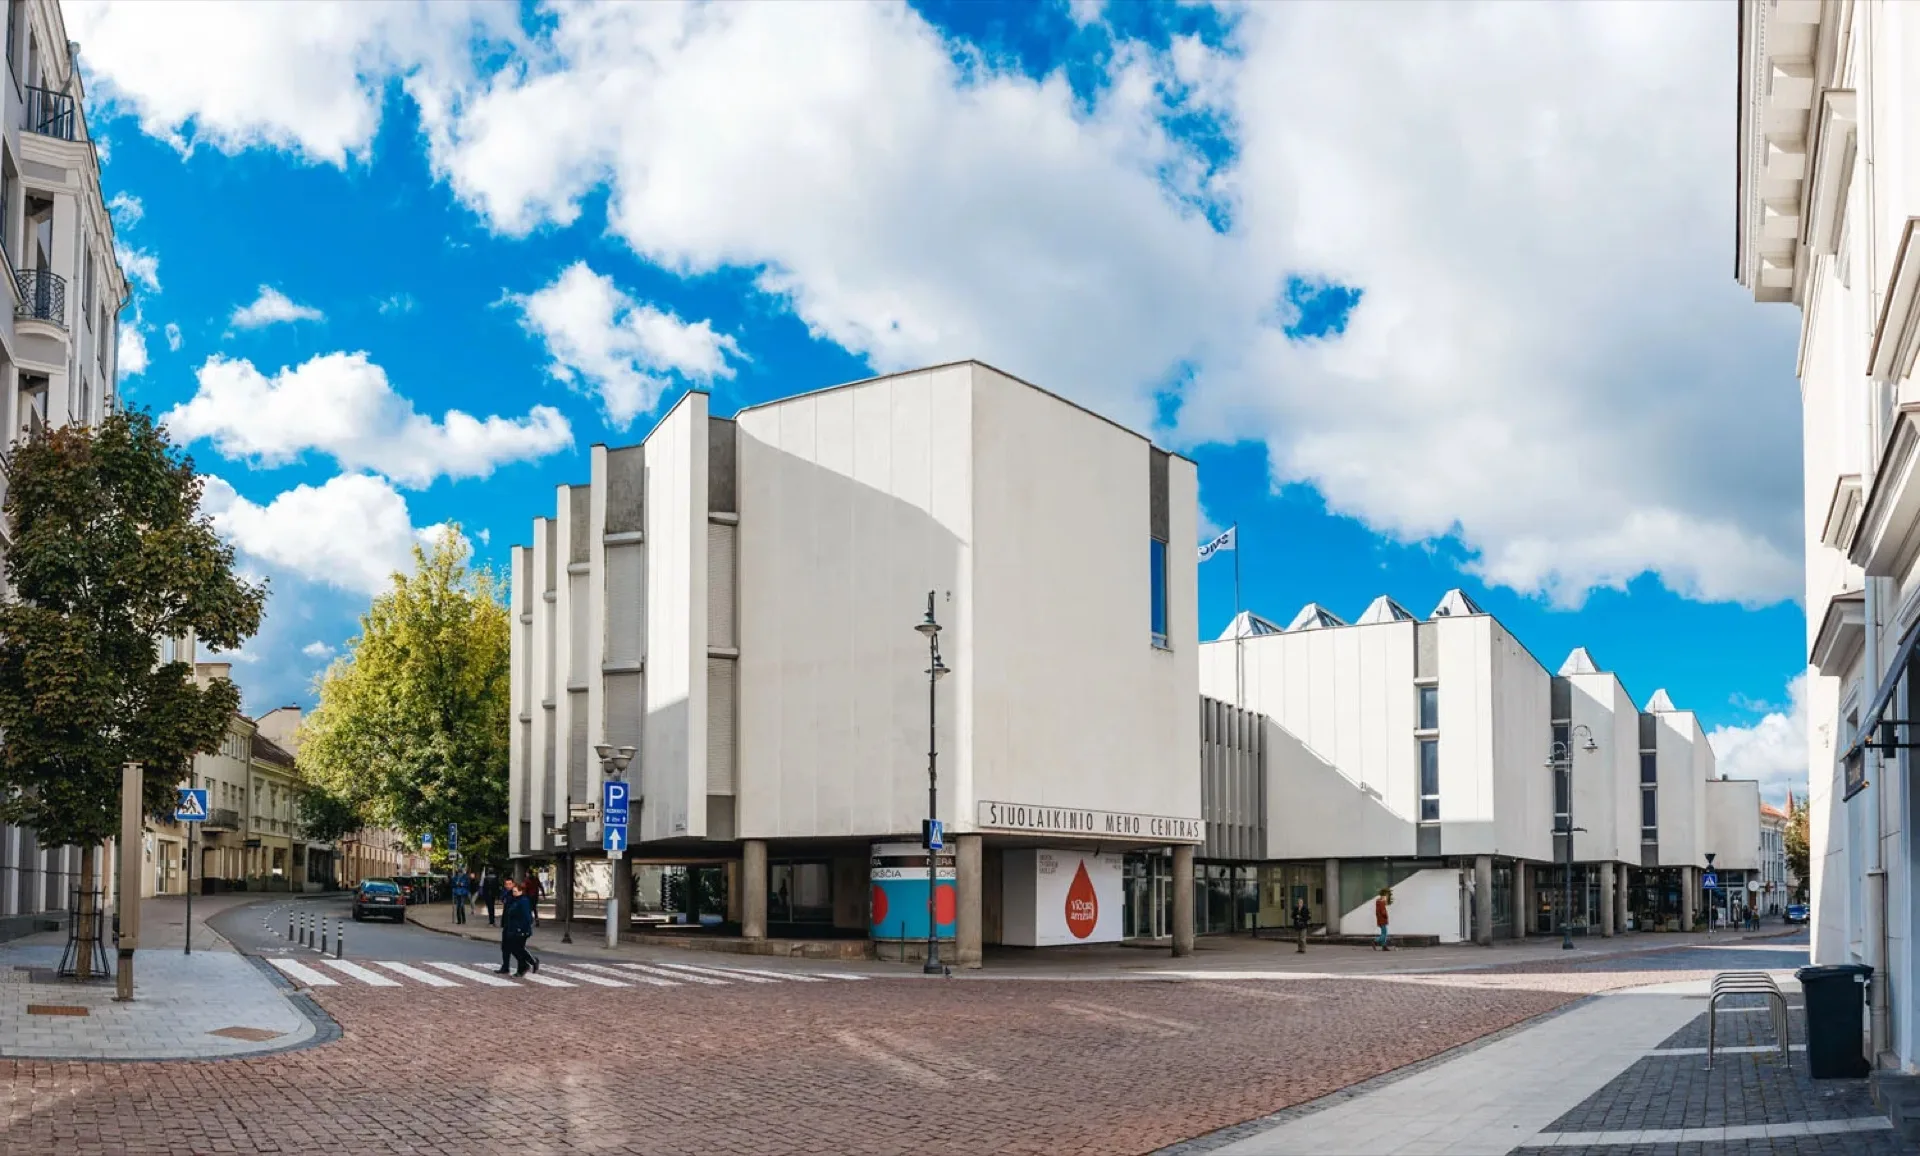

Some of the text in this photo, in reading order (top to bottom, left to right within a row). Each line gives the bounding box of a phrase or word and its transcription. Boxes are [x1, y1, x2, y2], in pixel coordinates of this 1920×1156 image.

[609, 785, 624, 807] P
[990, 802, 1199, 838] ŠIUOLAIKINIO MENO CENTRAS
